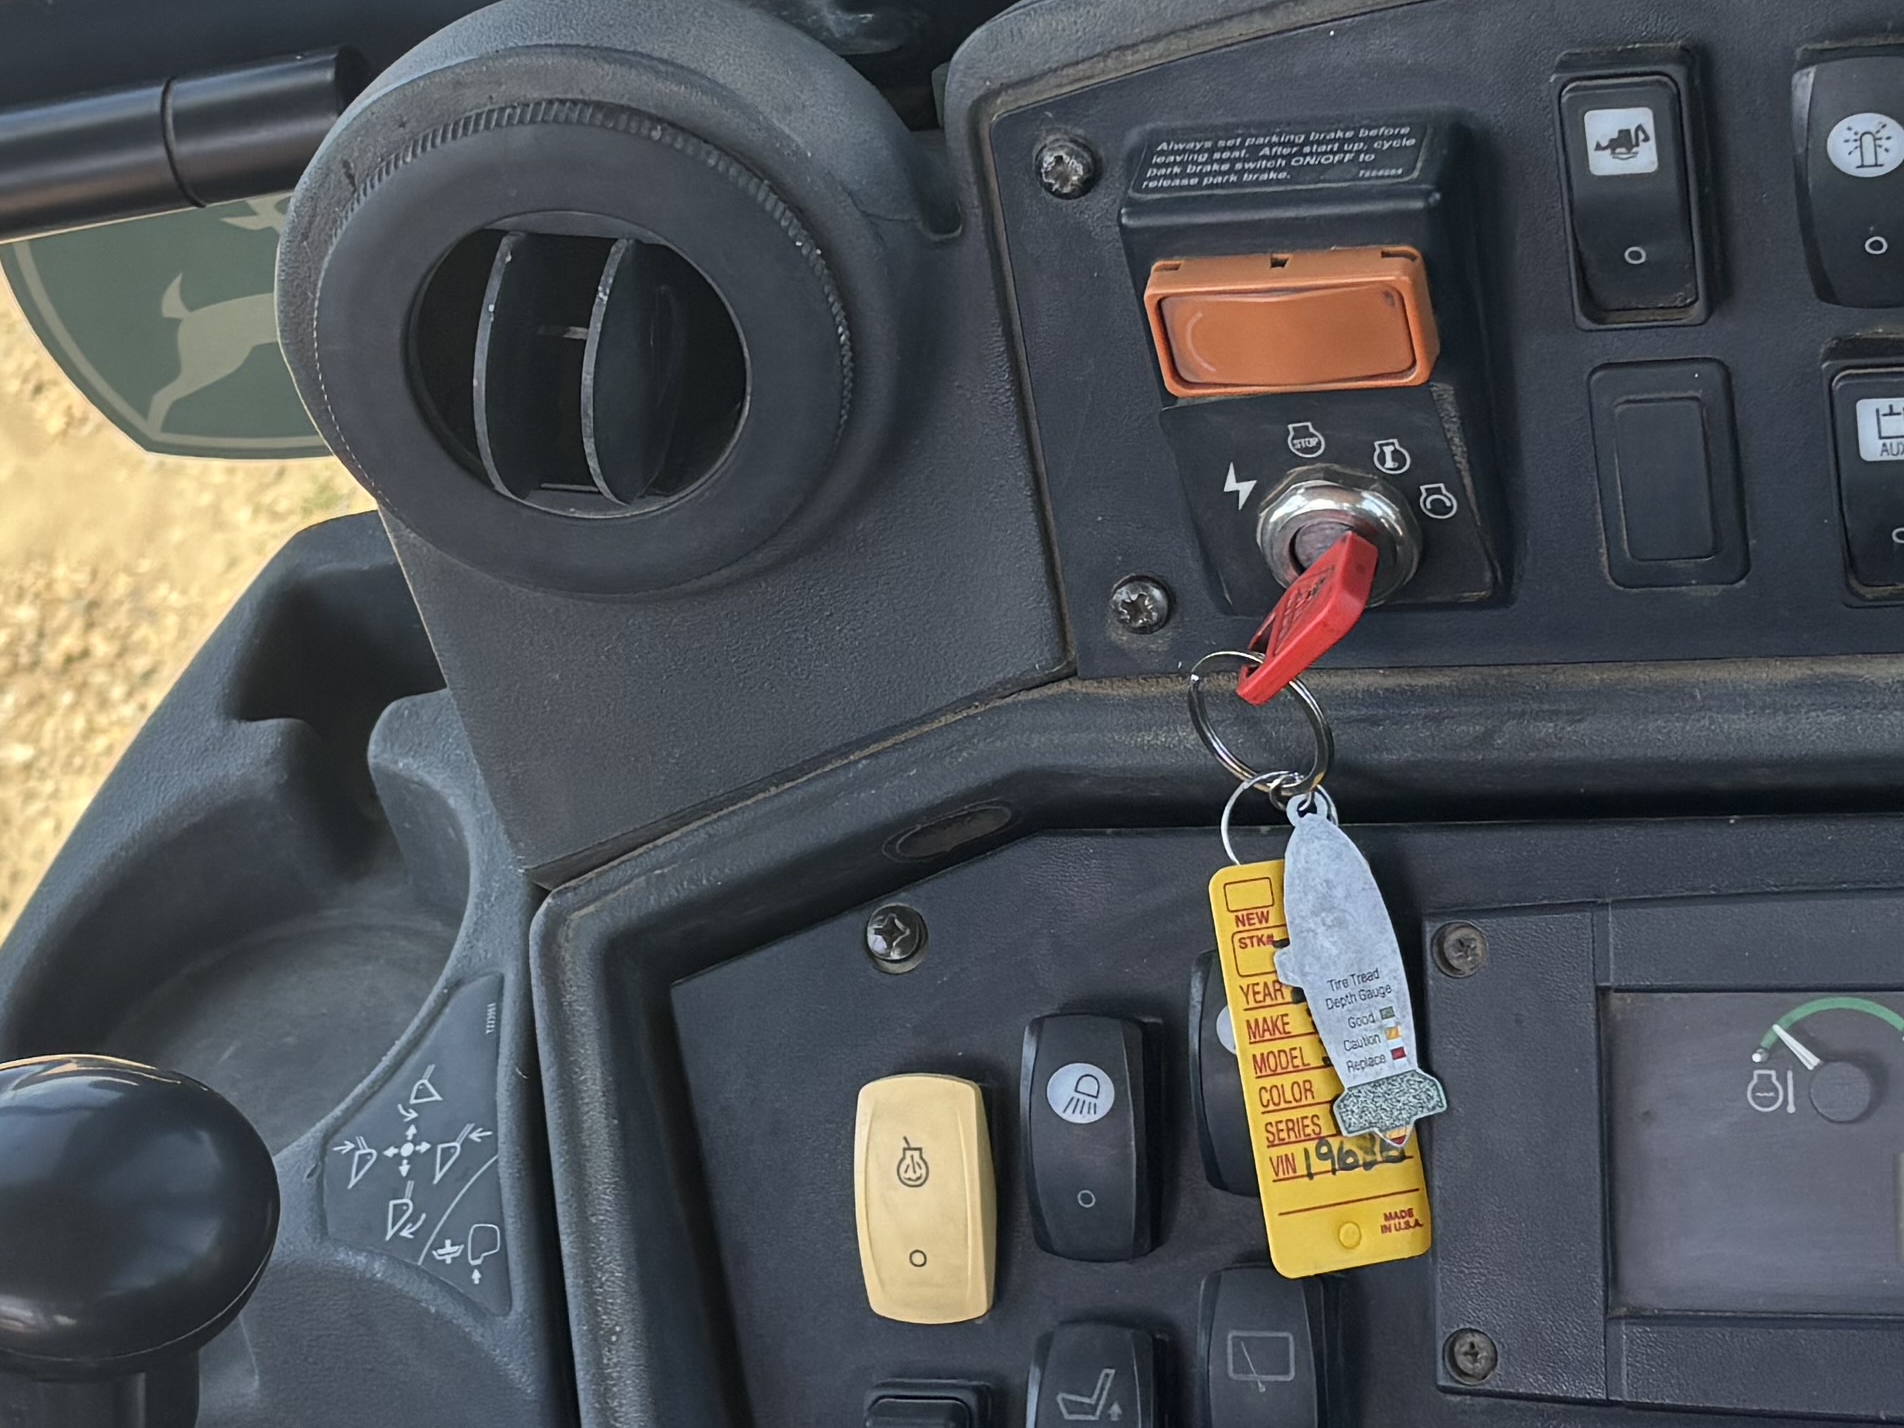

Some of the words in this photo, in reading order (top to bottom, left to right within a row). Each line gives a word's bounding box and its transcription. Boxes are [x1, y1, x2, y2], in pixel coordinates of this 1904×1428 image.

[1156, 140, 1213, 151] Always
[1217, 137, 1241, 148] set
[1245, 133, 1305, 147] parking
[1309, 129, 1354, 141] brake
[1359, 126, 1410, 138] before
[1151, 152, 1208, 165] leaving
[1212, 149, 1249, 160] seat.
[1259, 145, 1299, 157] After
[1302, 143, 1339, 153] start
[1373, 137, 1416, 151] cycle
[1146, 164, 1182, 178] park
[1186, 163, 1230, 174] brake
[1234, 158, 1286, 171] switch
[1291, 153, 1355, 166] ON/OFF
[1359, 153, 1375, 162] to
[1142, 177, 1199, 189] release
[1202, 173, 1237, 187] park
[1242, 170, 1291, 182] brake.
[1292, 437, 1319, 449] STOP
[1234, 910, 1270, 928] NEW
[1238, 934, 1274, 949] STK#
[1327, 977, 1350, 992] Tire
[1350, 968, 1380, 986] Tread
[1239, 980, 1285, 1005] YEAR
[1325, 993, 1357, 1010] Depth
[1358, 984, 1392, 1001] Gauge
[1246, 1013, 1292, 1040] MAKE
[1347, 1013, 1376, 1029] Good
[1343, 1034, 1381, 1052] Caution
[1252, 1046, 1310, 1075] MODEL
[1346, 1054, 1387, 1074] Replace
[1259, 1079, 1315, 1108] COLOR
[1265, 1114, 1322, 1143] SERIES
[1269, 1152, 1297, 1177] VIN
[1383, 1207, 1414, 1223] MADE
[1380, 1223, 1392, 1234] IN
